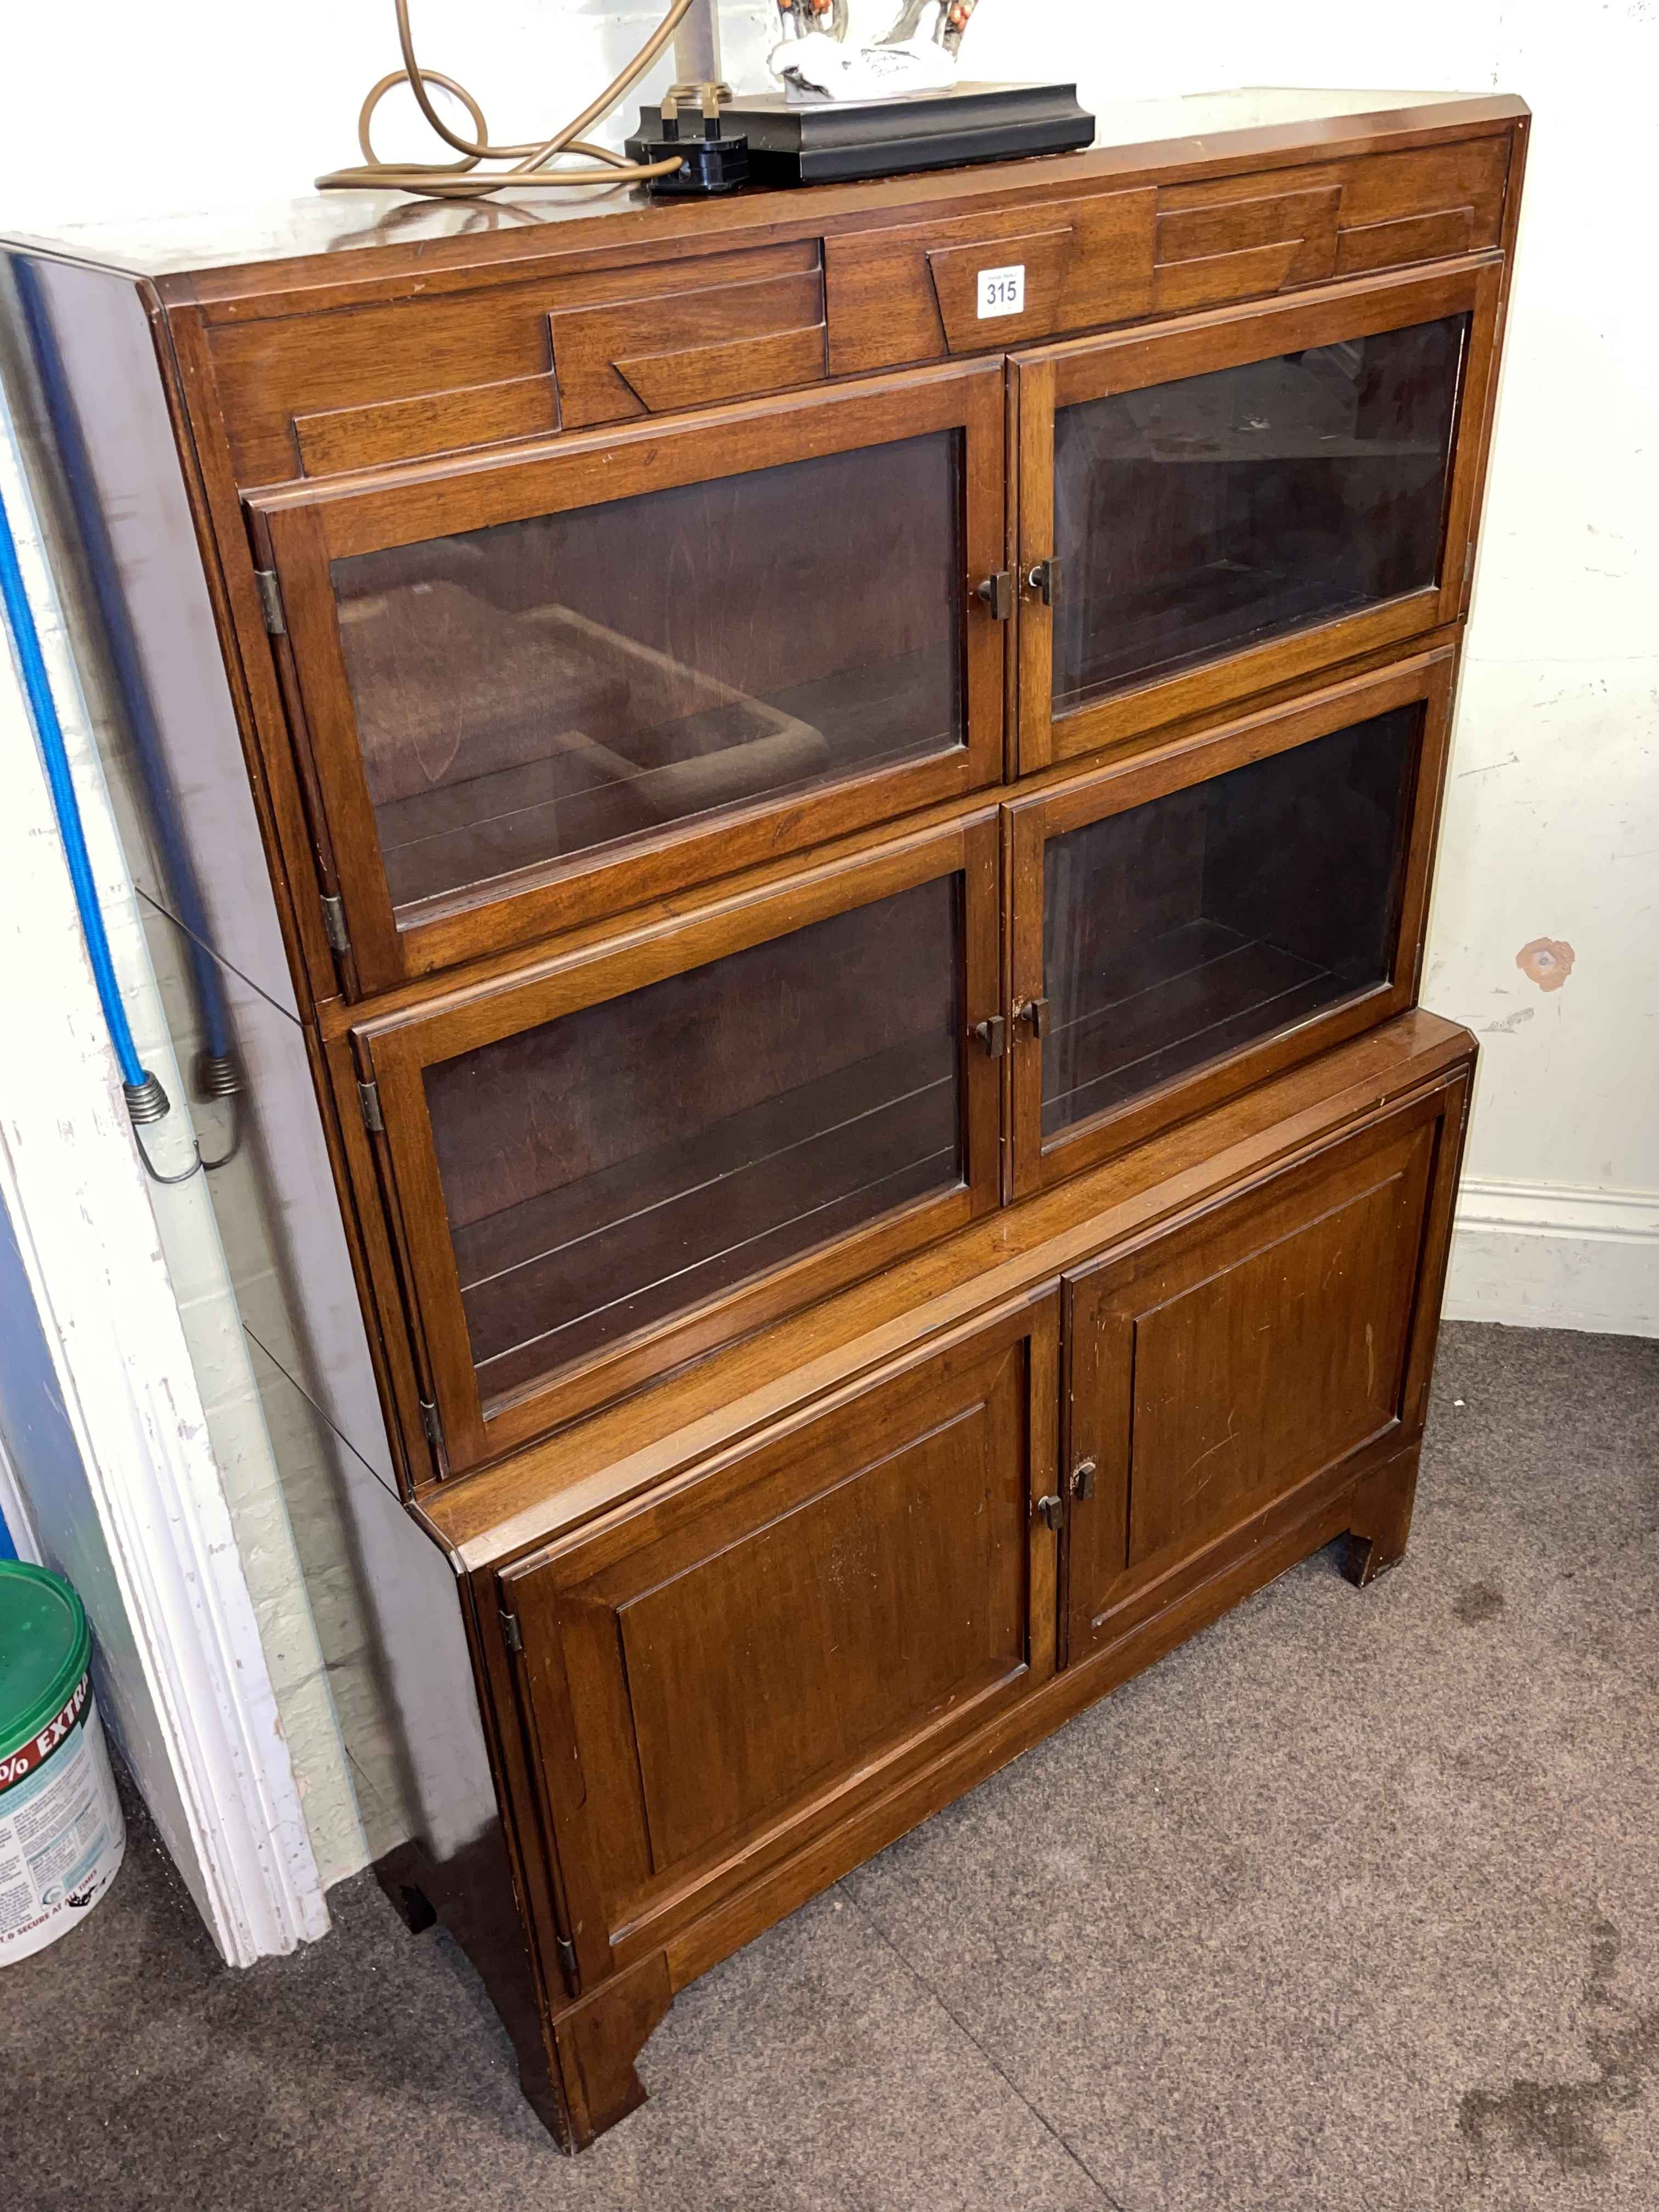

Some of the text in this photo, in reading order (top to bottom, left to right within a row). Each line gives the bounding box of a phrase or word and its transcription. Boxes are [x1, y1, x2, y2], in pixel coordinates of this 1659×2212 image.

[987, 280, 1017, 304] 315
[36, 1672, 88, 1757] EXTRA
[17, 1912, 50, 1936] SECURE
[52, 1903, 62, 1915] AT
[79, 1868, 97, 1892] TIMES
